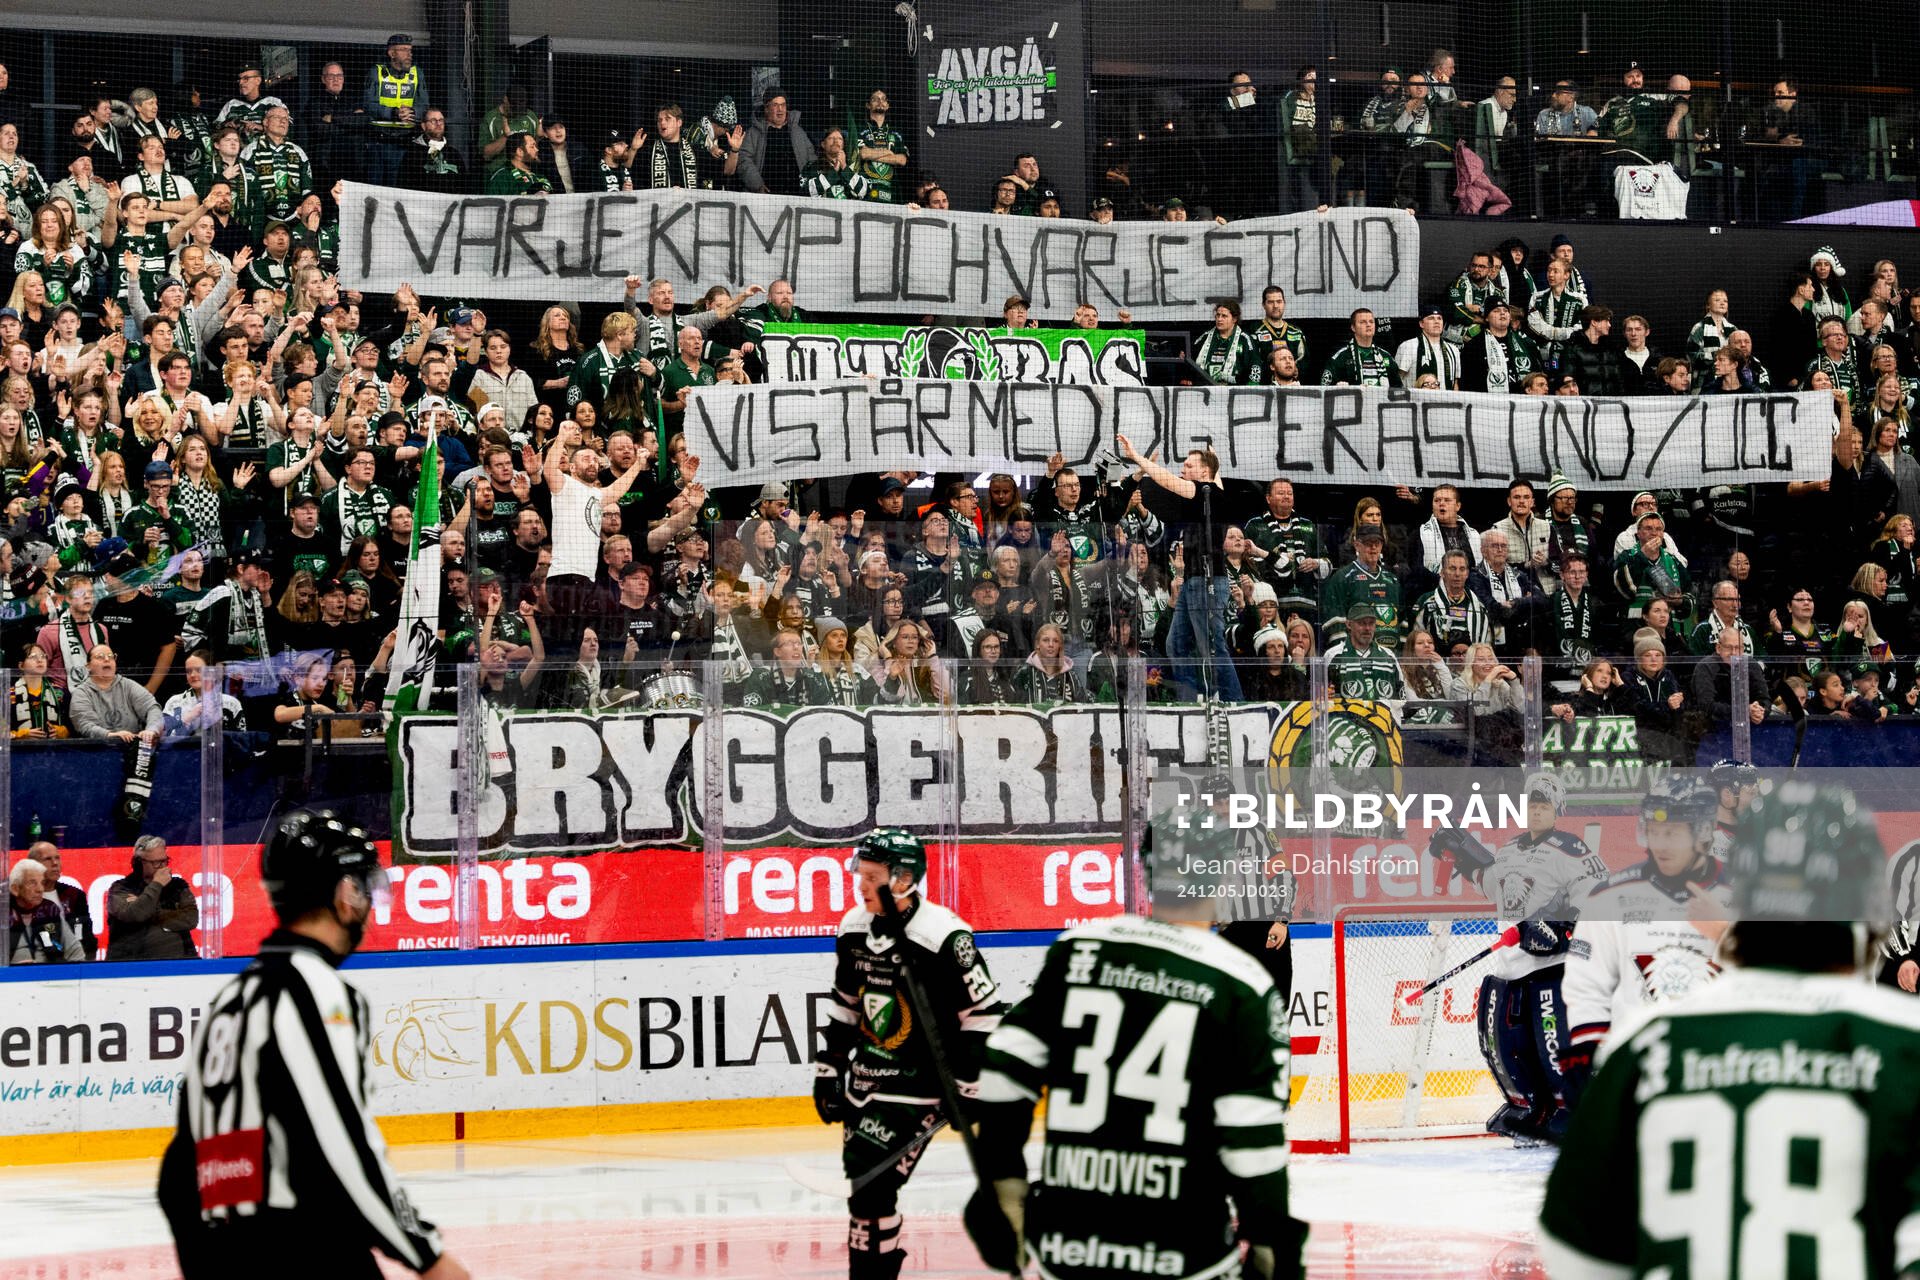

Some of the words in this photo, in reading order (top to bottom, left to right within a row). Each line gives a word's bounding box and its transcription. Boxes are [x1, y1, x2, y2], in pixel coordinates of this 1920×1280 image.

[936, 86, 1046, 125] ABBE
[360, 195, 378, 279] I
[394, 195, 638, 279] VARJE
[646, 200, 842, 292] KAMP
[853, 212, 990, 304] OCH
[994, 226, 1197, 308] VARJE
[1203, 216, 1401, 305] STUND
[696, 391, 754, 472] VI
[769, 377, 953, 464] STÅR
[967, 382, 1102, 468] MED
[1112, 386, 1213, 468] DIG
[1227, 387, 1369, 475] PER
[366, 857, 593, 926] renta
[955, 963, 997, 1003] 29
[1098, 961, 1215, 1008] Infrakraft
[1047, 986, 1201, 1147] 34
[1681, 1040, 1884, 1094] Infrakraft
[1044, 1145, 1188, 1201] LINDQVIST
[1636, 1086, 1871, 1280] 98
[1039, 1231, 1186, 1278] Helmia
